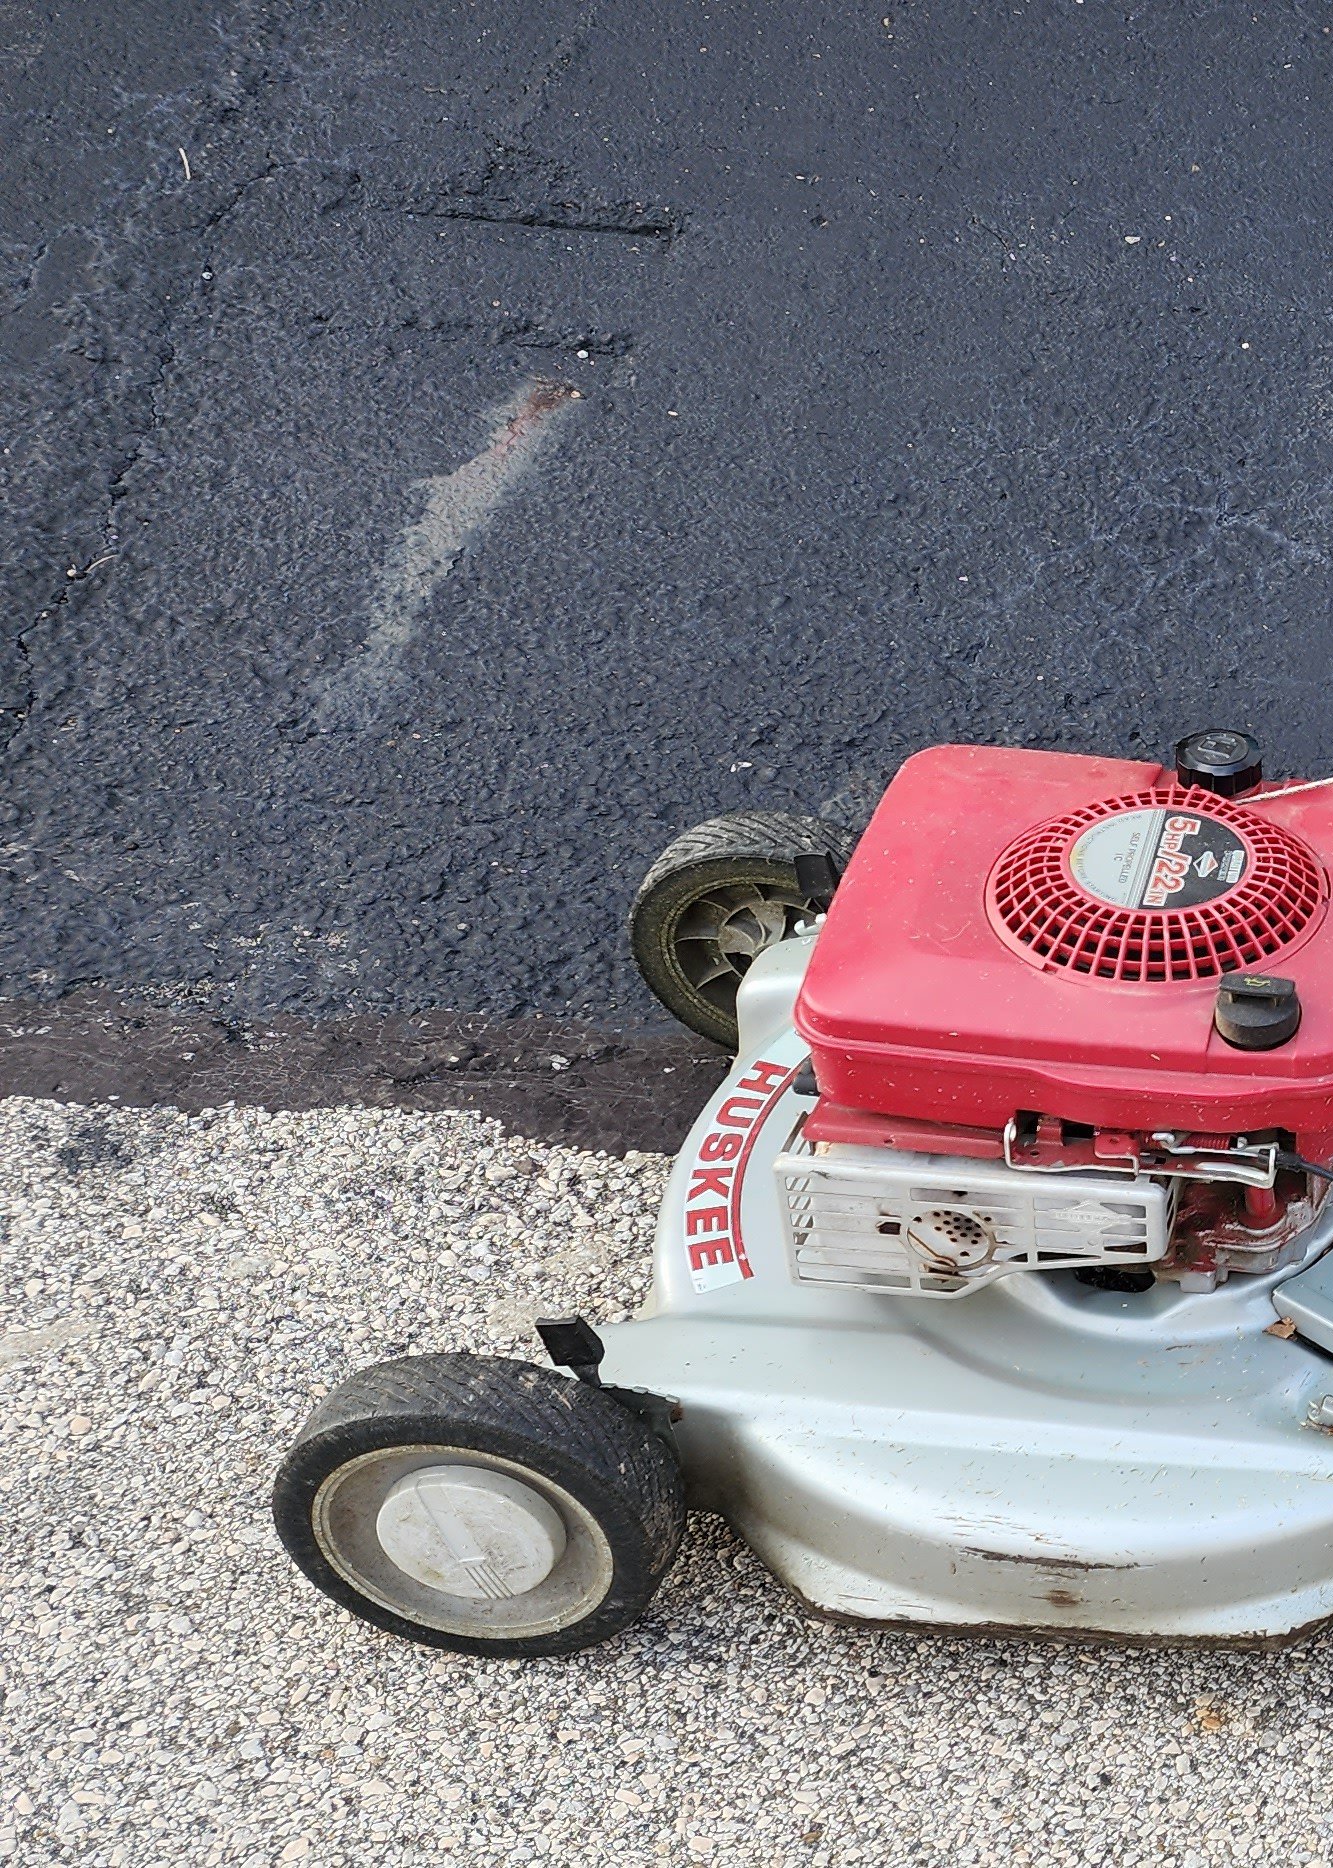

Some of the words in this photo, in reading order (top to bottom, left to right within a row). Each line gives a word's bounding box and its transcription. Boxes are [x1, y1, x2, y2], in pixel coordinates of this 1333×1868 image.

[1129, 832, 1141, 848] SELF
[1118, 848, 1137, 884] PROPELLED
[686, 1060, 791, 1271] HUSKEE
